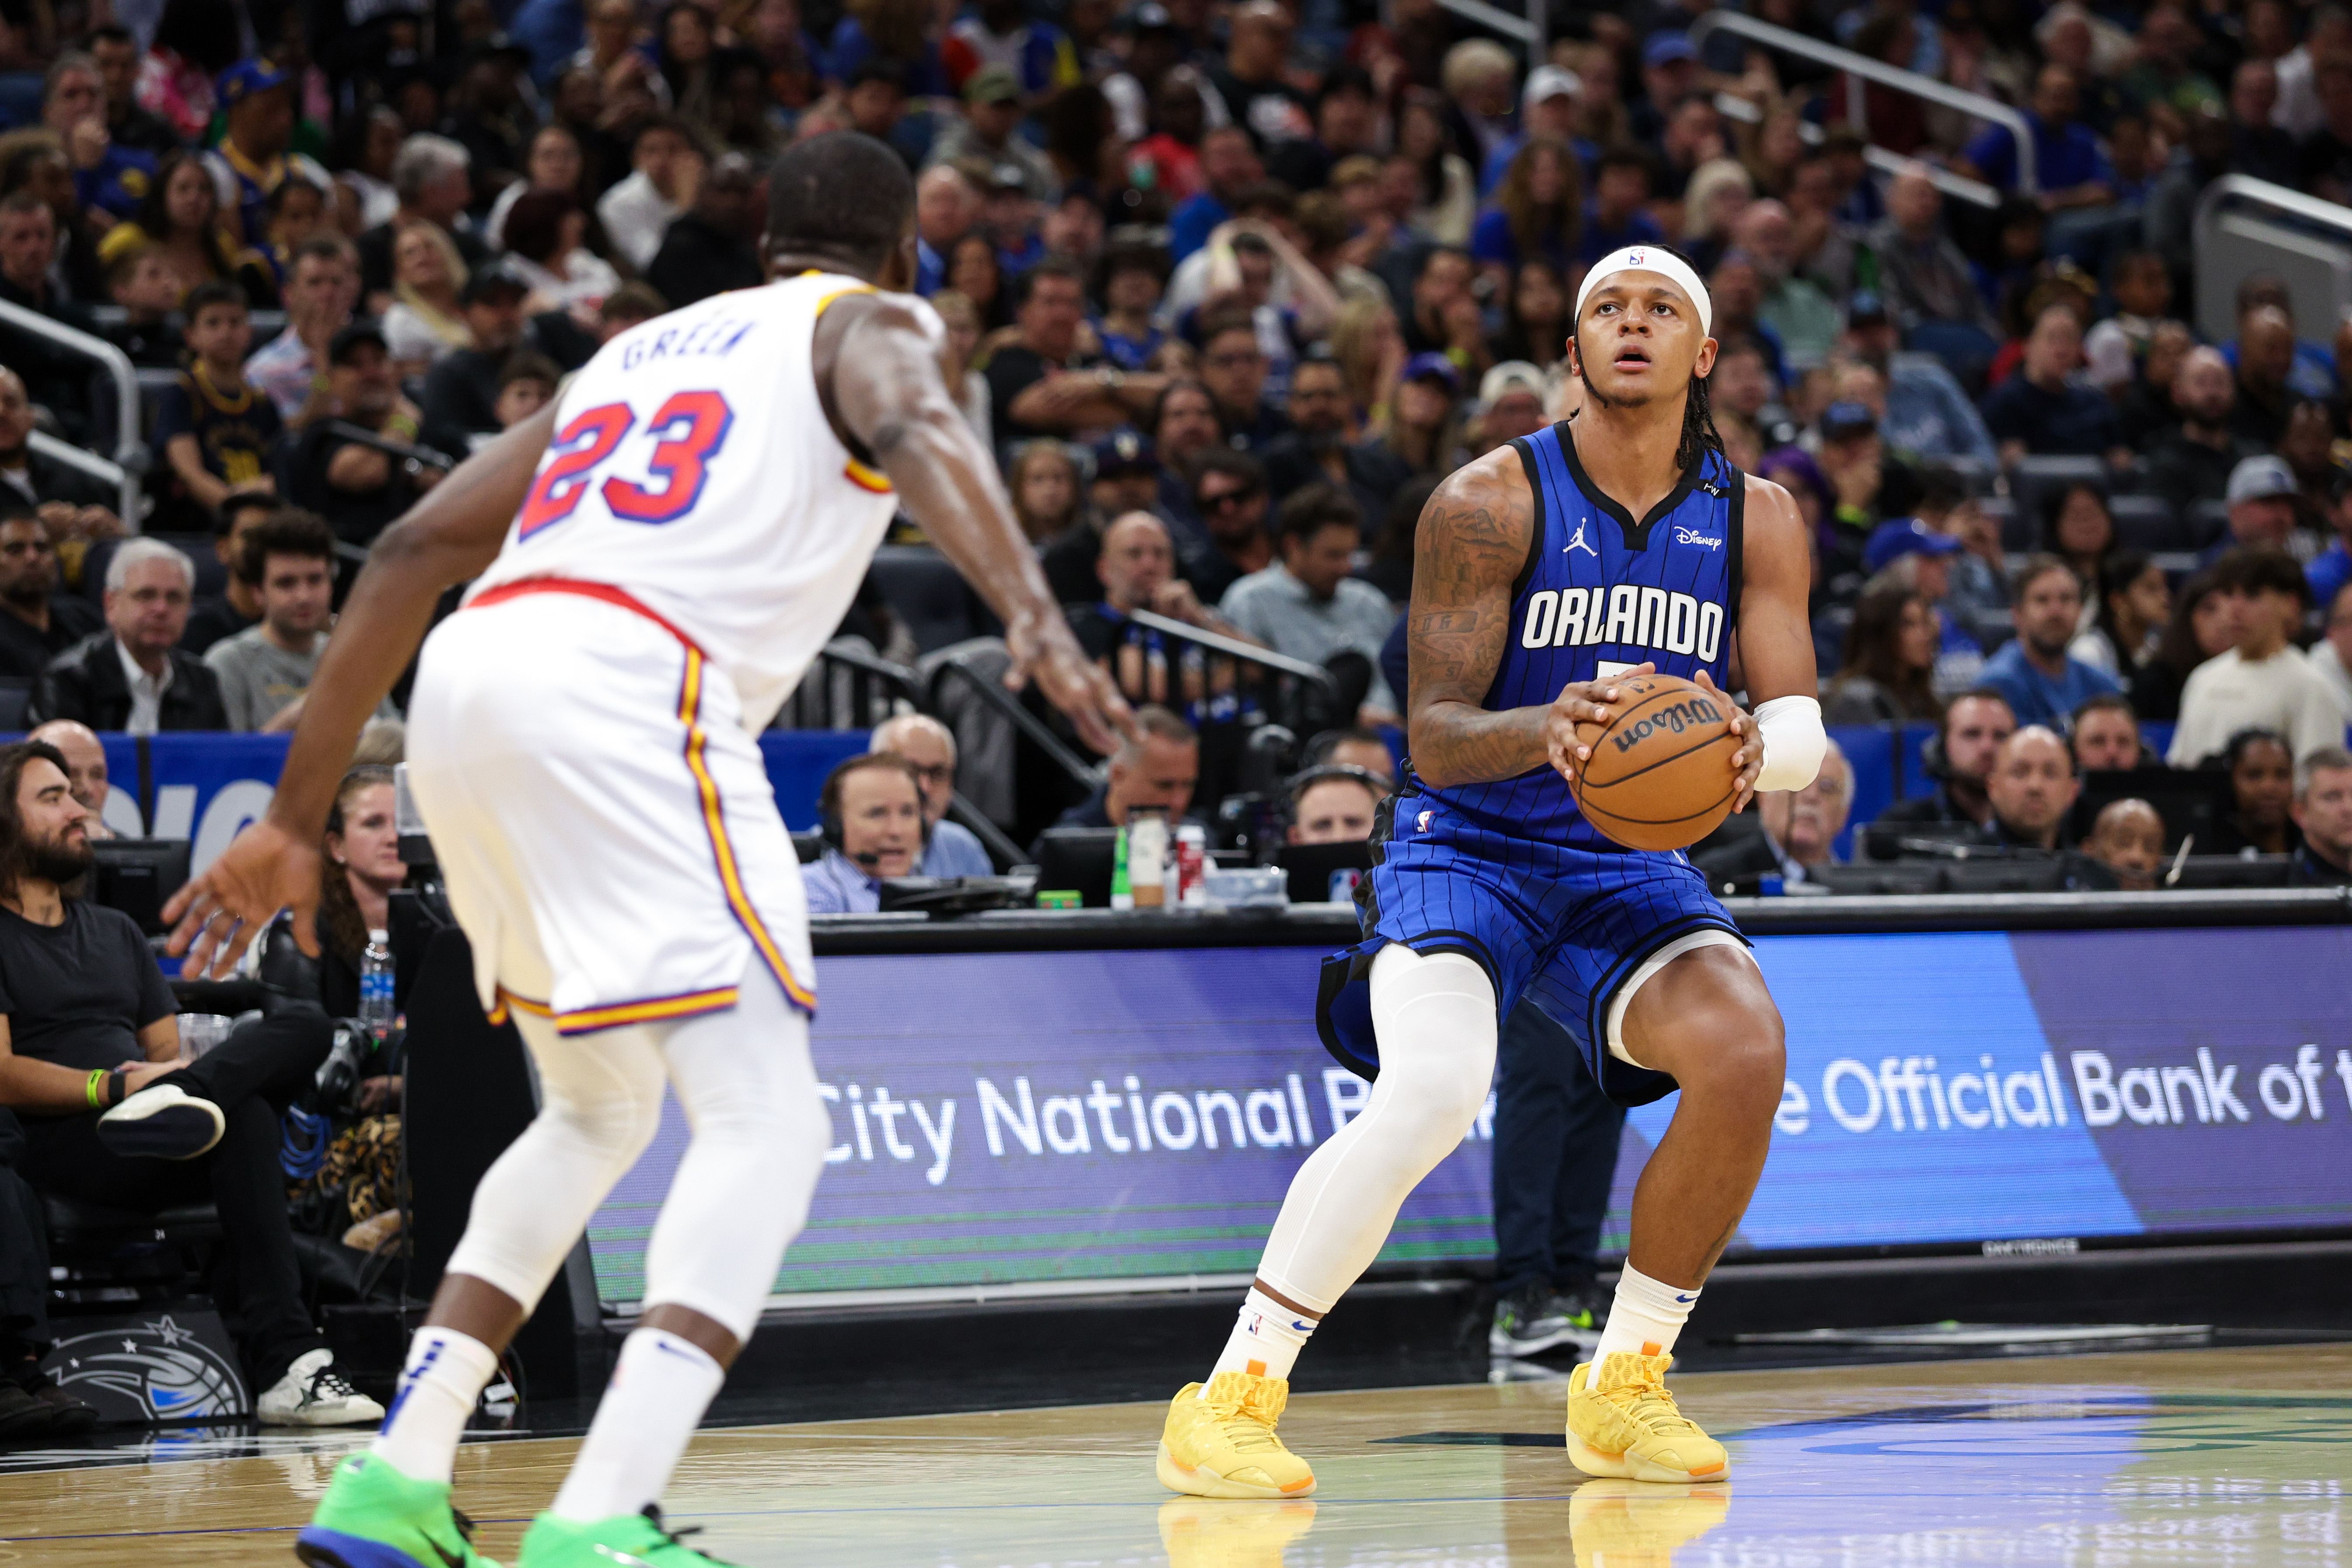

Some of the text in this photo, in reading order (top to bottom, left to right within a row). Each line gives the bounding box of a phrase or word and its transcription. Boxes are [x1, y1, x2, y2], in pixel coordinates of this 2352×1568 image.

[622, 319, 755, 370] GREEN
[519, 389, 735, 543] 23
[1521, 584, 1724, 663] ORLANDO
[1611, 698, 1724, 753] Wilson
[975, 1073, 1314, 1156] National
[1821, 1051, 2069, 1133] Official
[2071, 1046, 2251, 1127] Bank
[2258, 1044, 2324, 1121] of
